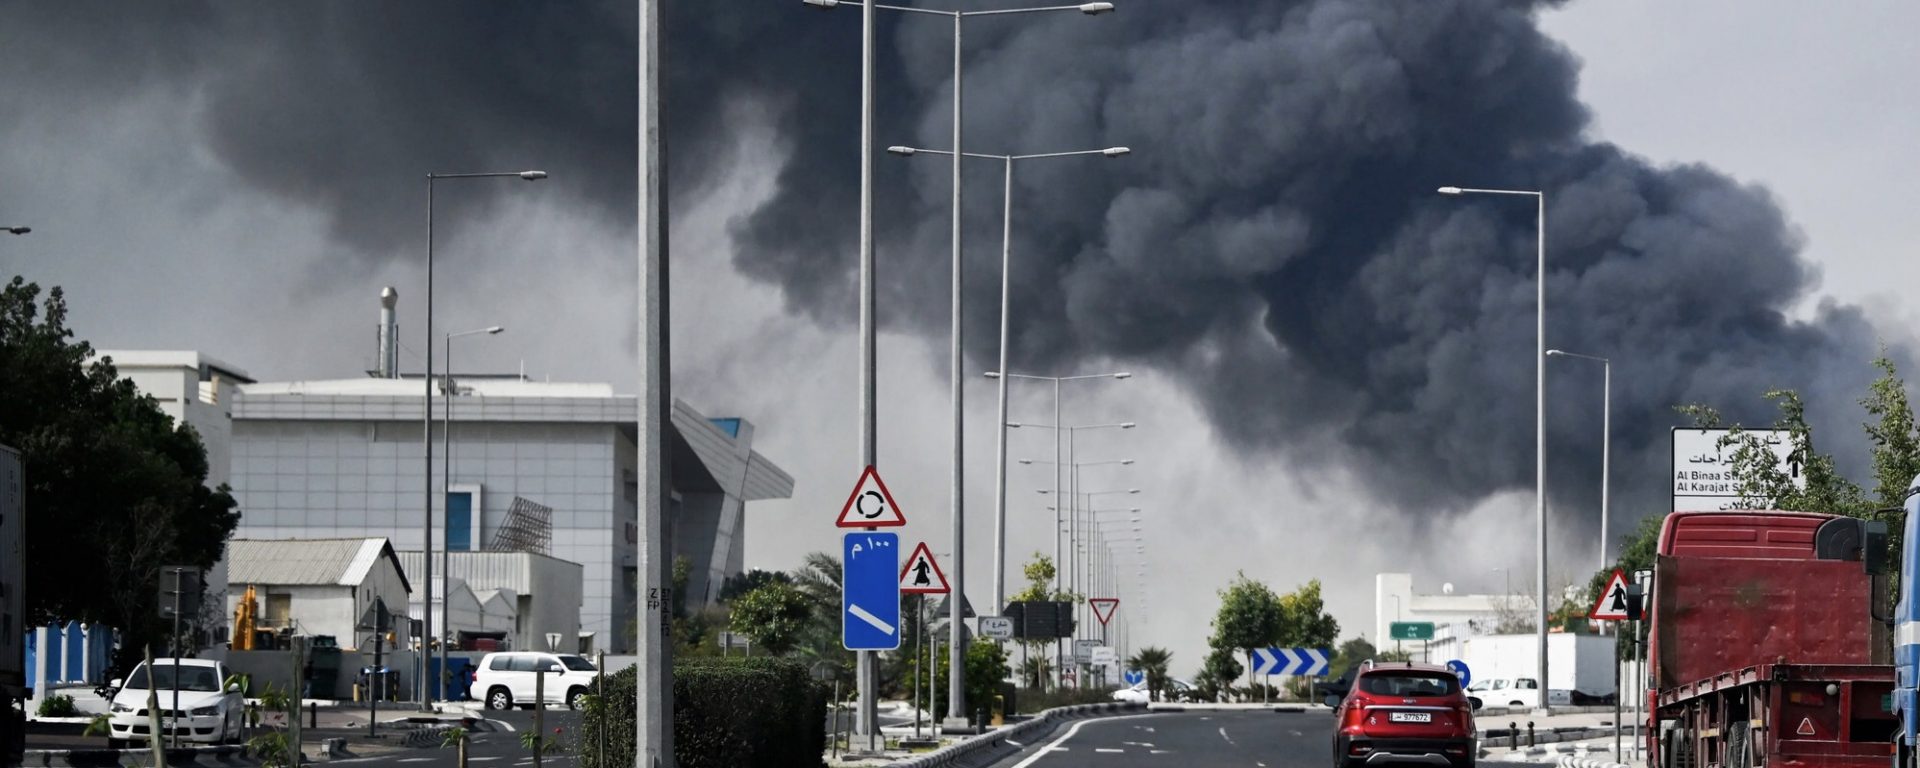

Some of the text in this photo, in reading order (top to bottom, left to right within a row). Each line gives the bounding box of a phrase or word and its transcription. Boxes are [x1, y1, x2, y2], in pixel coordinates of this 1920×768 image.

[1677, 471, 1688, 480] Al
[1691, 471, 1721, 480] Binaa
[1677, 482, 1688, 492] Al
[1691, 482, 1729, 493] Karajat
[851, 536, 889, 560] ١٠٠ م
